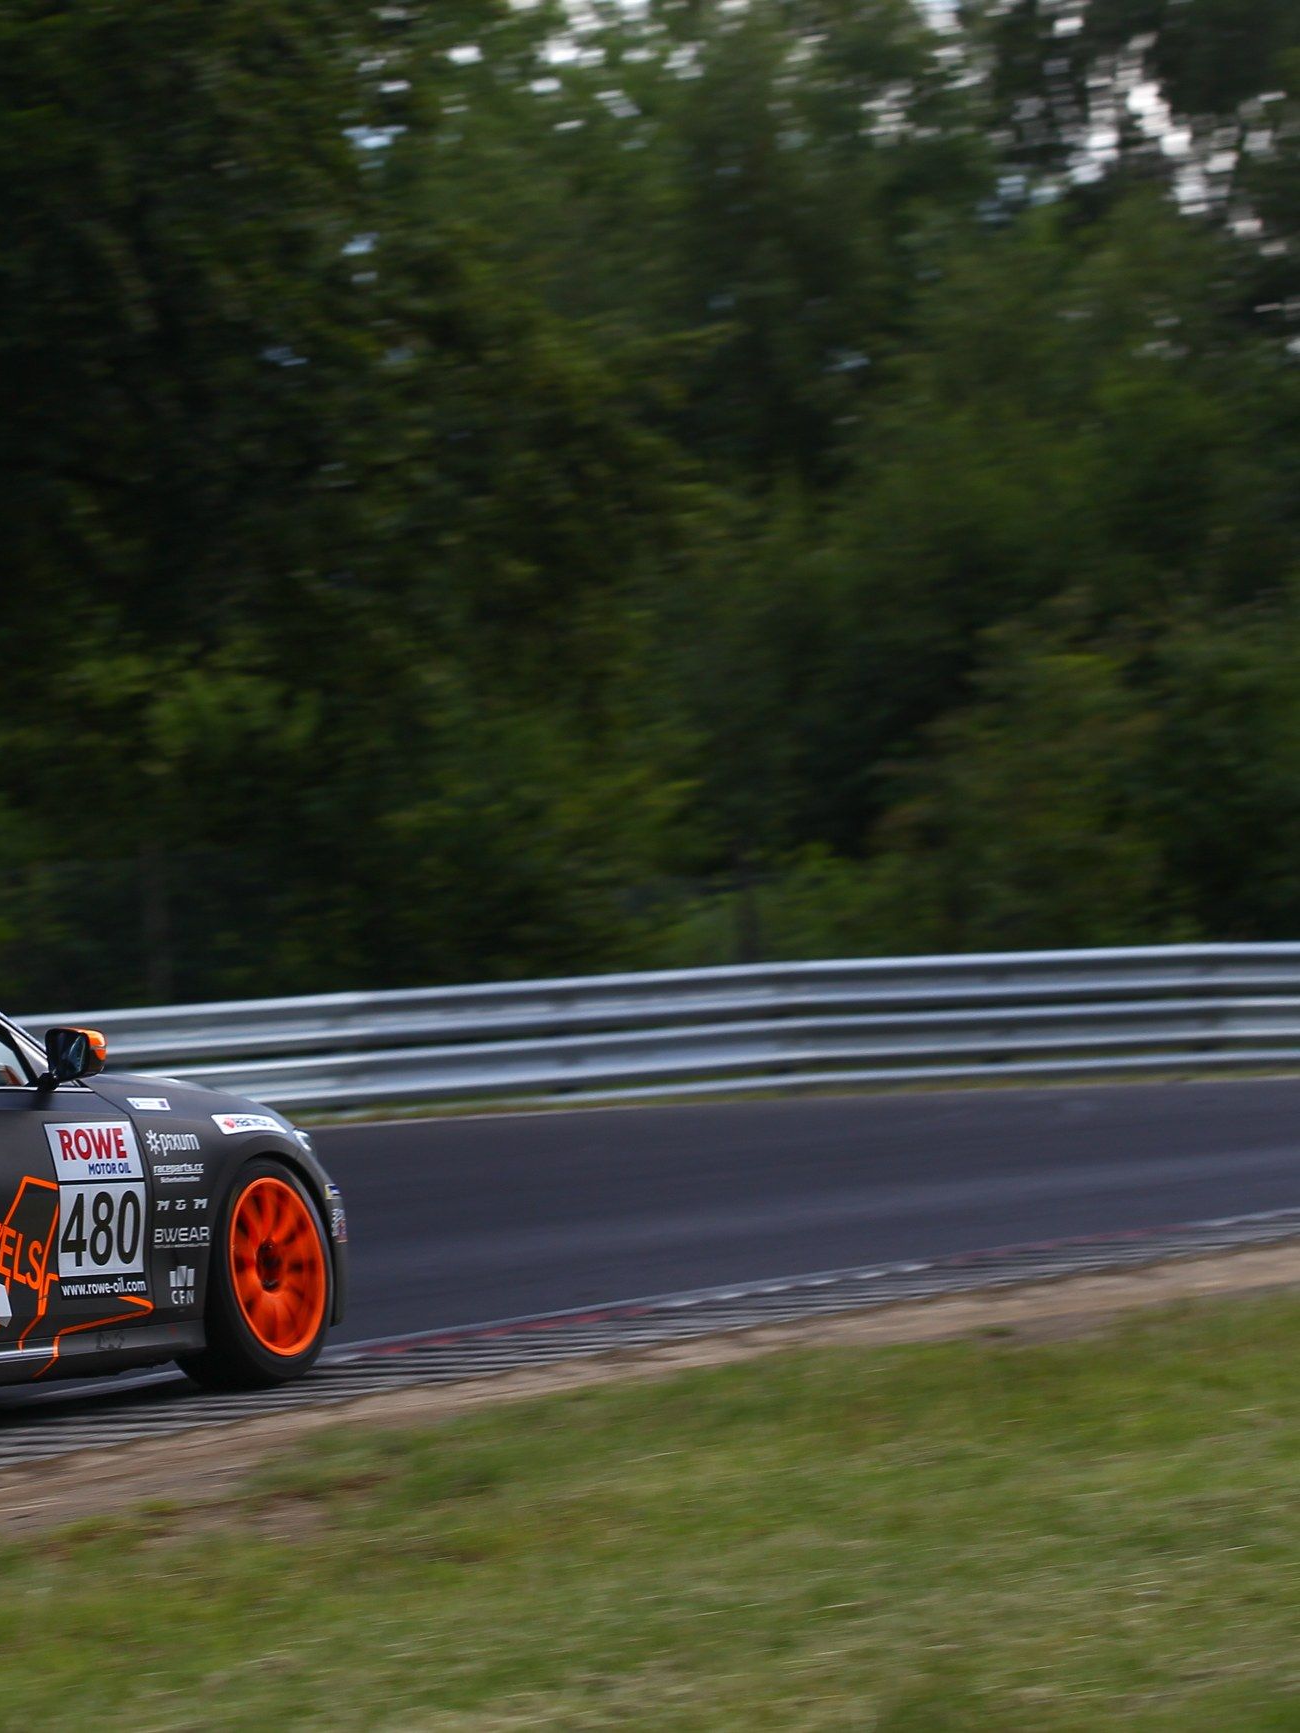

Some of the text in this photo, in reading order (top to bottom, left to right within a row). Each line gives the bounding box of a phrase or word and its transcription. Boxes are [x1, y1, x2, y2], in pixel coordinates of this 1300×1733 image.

[55, 1128, 128, 1161] ROWE
[159, 1133, 200, 1157] pixum
[88, 1162, 132, 1175] MOTOR OIL
[156, 1200, 171, 1211] M
[193, 1198, 208, 1210] M
[60, 1190, 141, 1268] 480
[153, 1226, 210, 1243] BWEAR
[61, 1277, 147, 1297] www.rowe-oil.com
